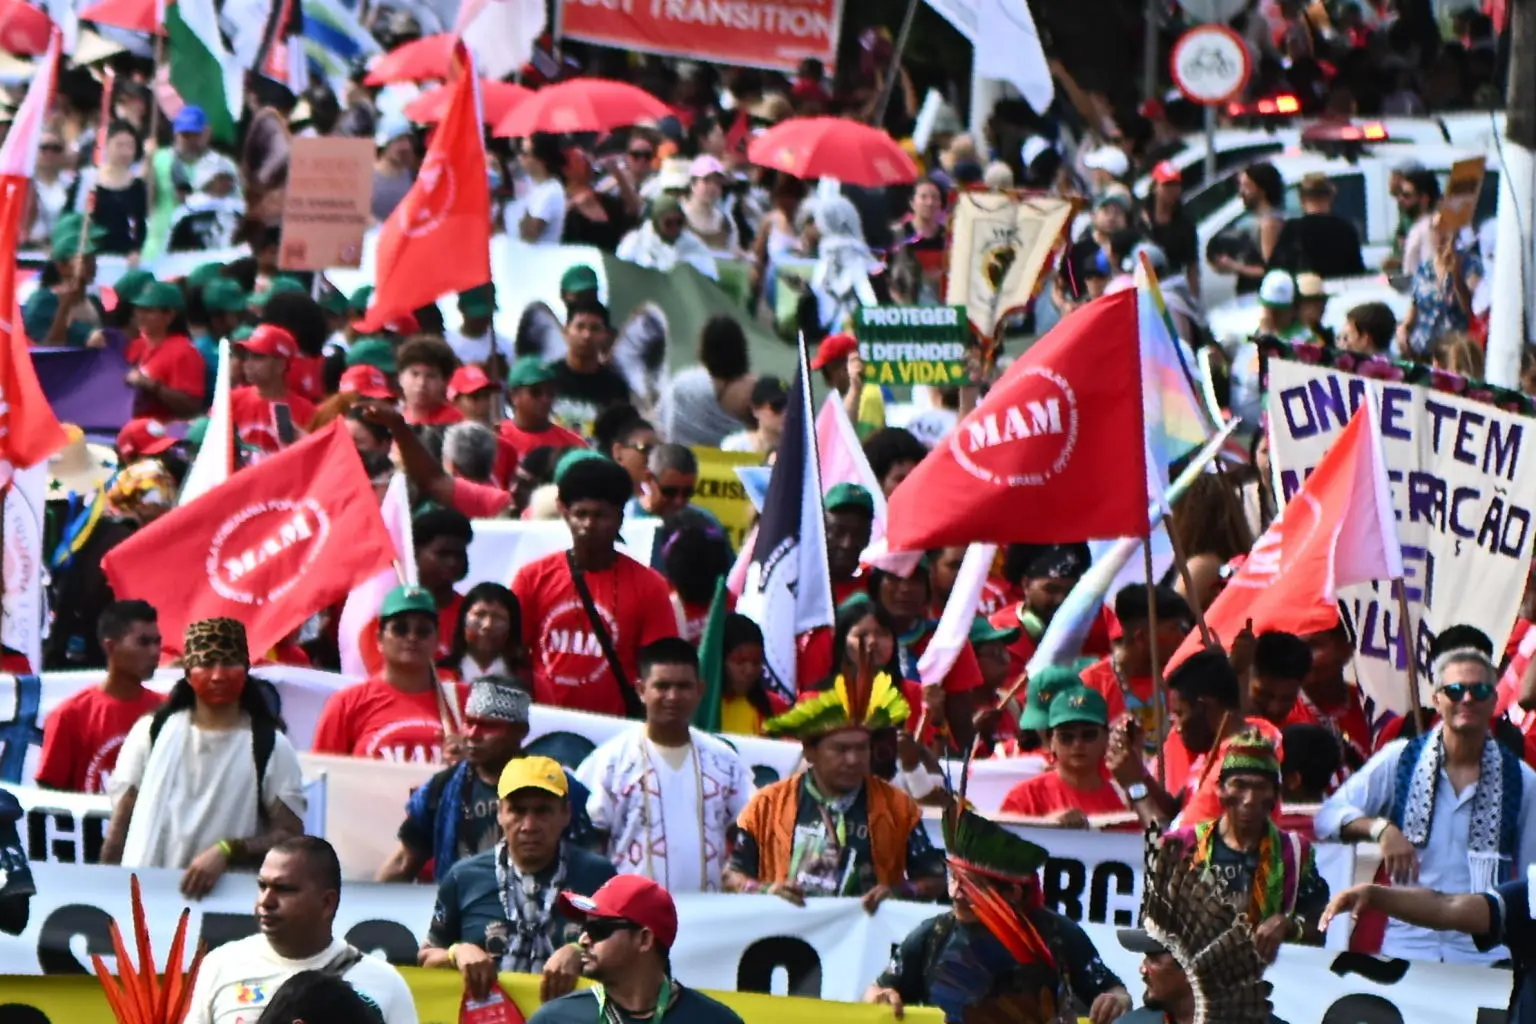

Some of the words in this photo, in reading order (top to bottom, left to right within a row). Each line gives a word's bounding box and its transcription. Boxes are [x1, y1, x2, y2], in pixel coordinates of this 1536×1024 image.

[863, 307, 958, 326] PROTEGER
[873, 343, 965, 362] DEFENDER
[880, 363, 894, 384] A
[897, 362, 949, 384] VIDA
[967, 396, 1064, 453] MAM
[1425, 399, 1524, 481] TEM
[223, 511, 313, 583] MAM
[549, 628, 604, 658] MAM
